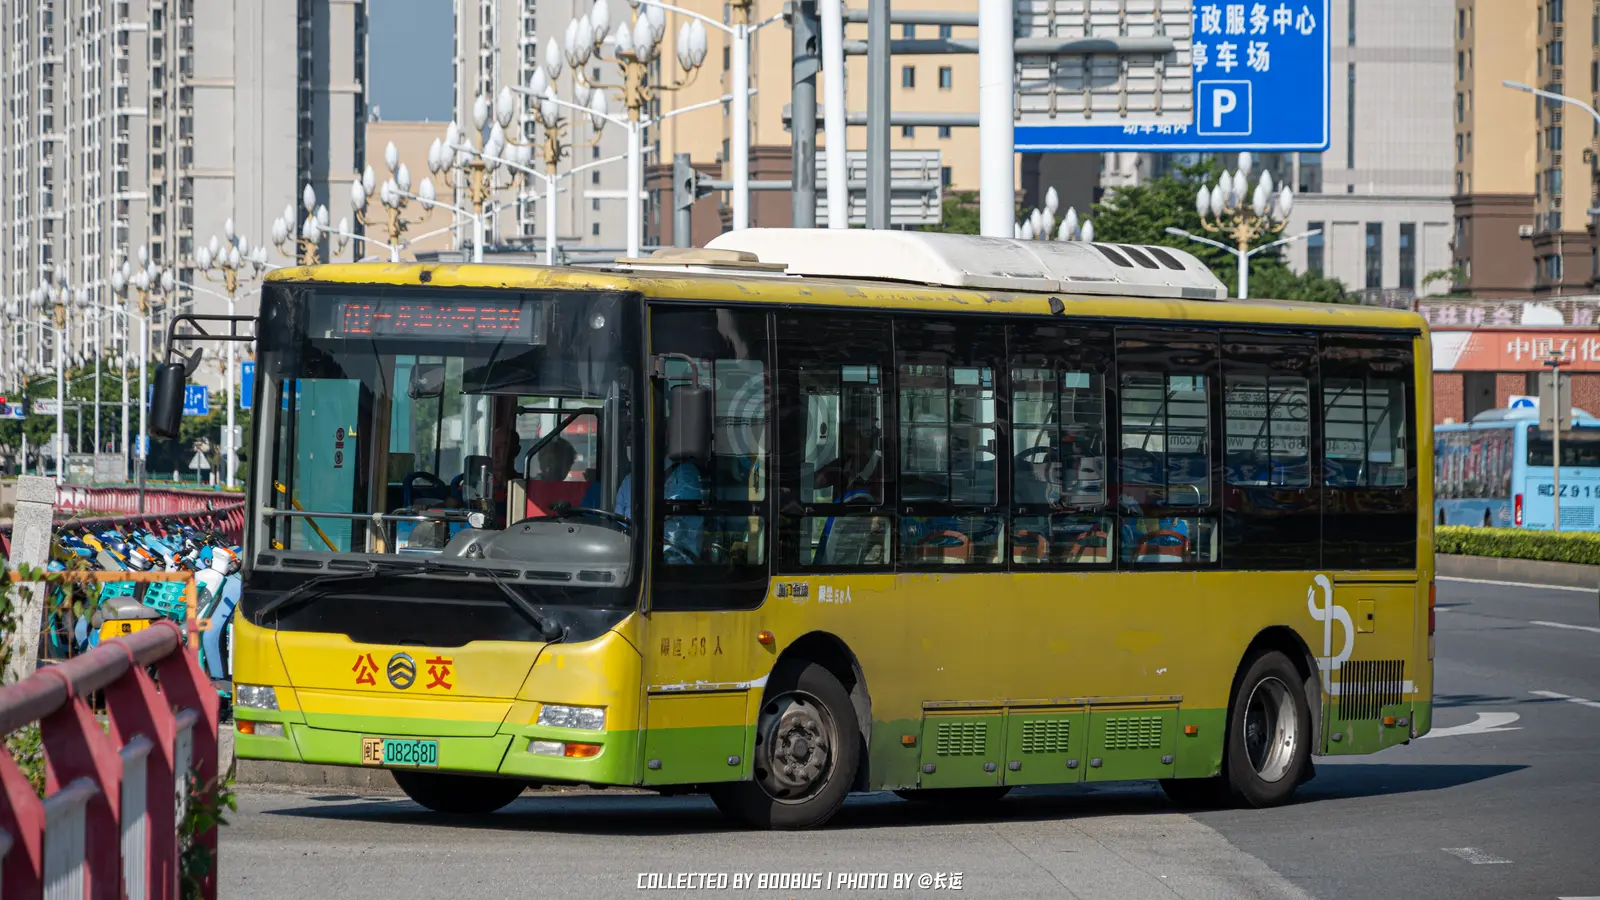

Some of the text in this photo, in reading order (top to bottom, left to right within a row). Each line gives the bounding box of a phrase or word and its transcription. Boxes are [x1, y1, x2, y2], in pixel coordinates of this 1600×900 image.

[1212, 88, 1237, 128] P
[1507, 336, 1600, 362] 中国石化
